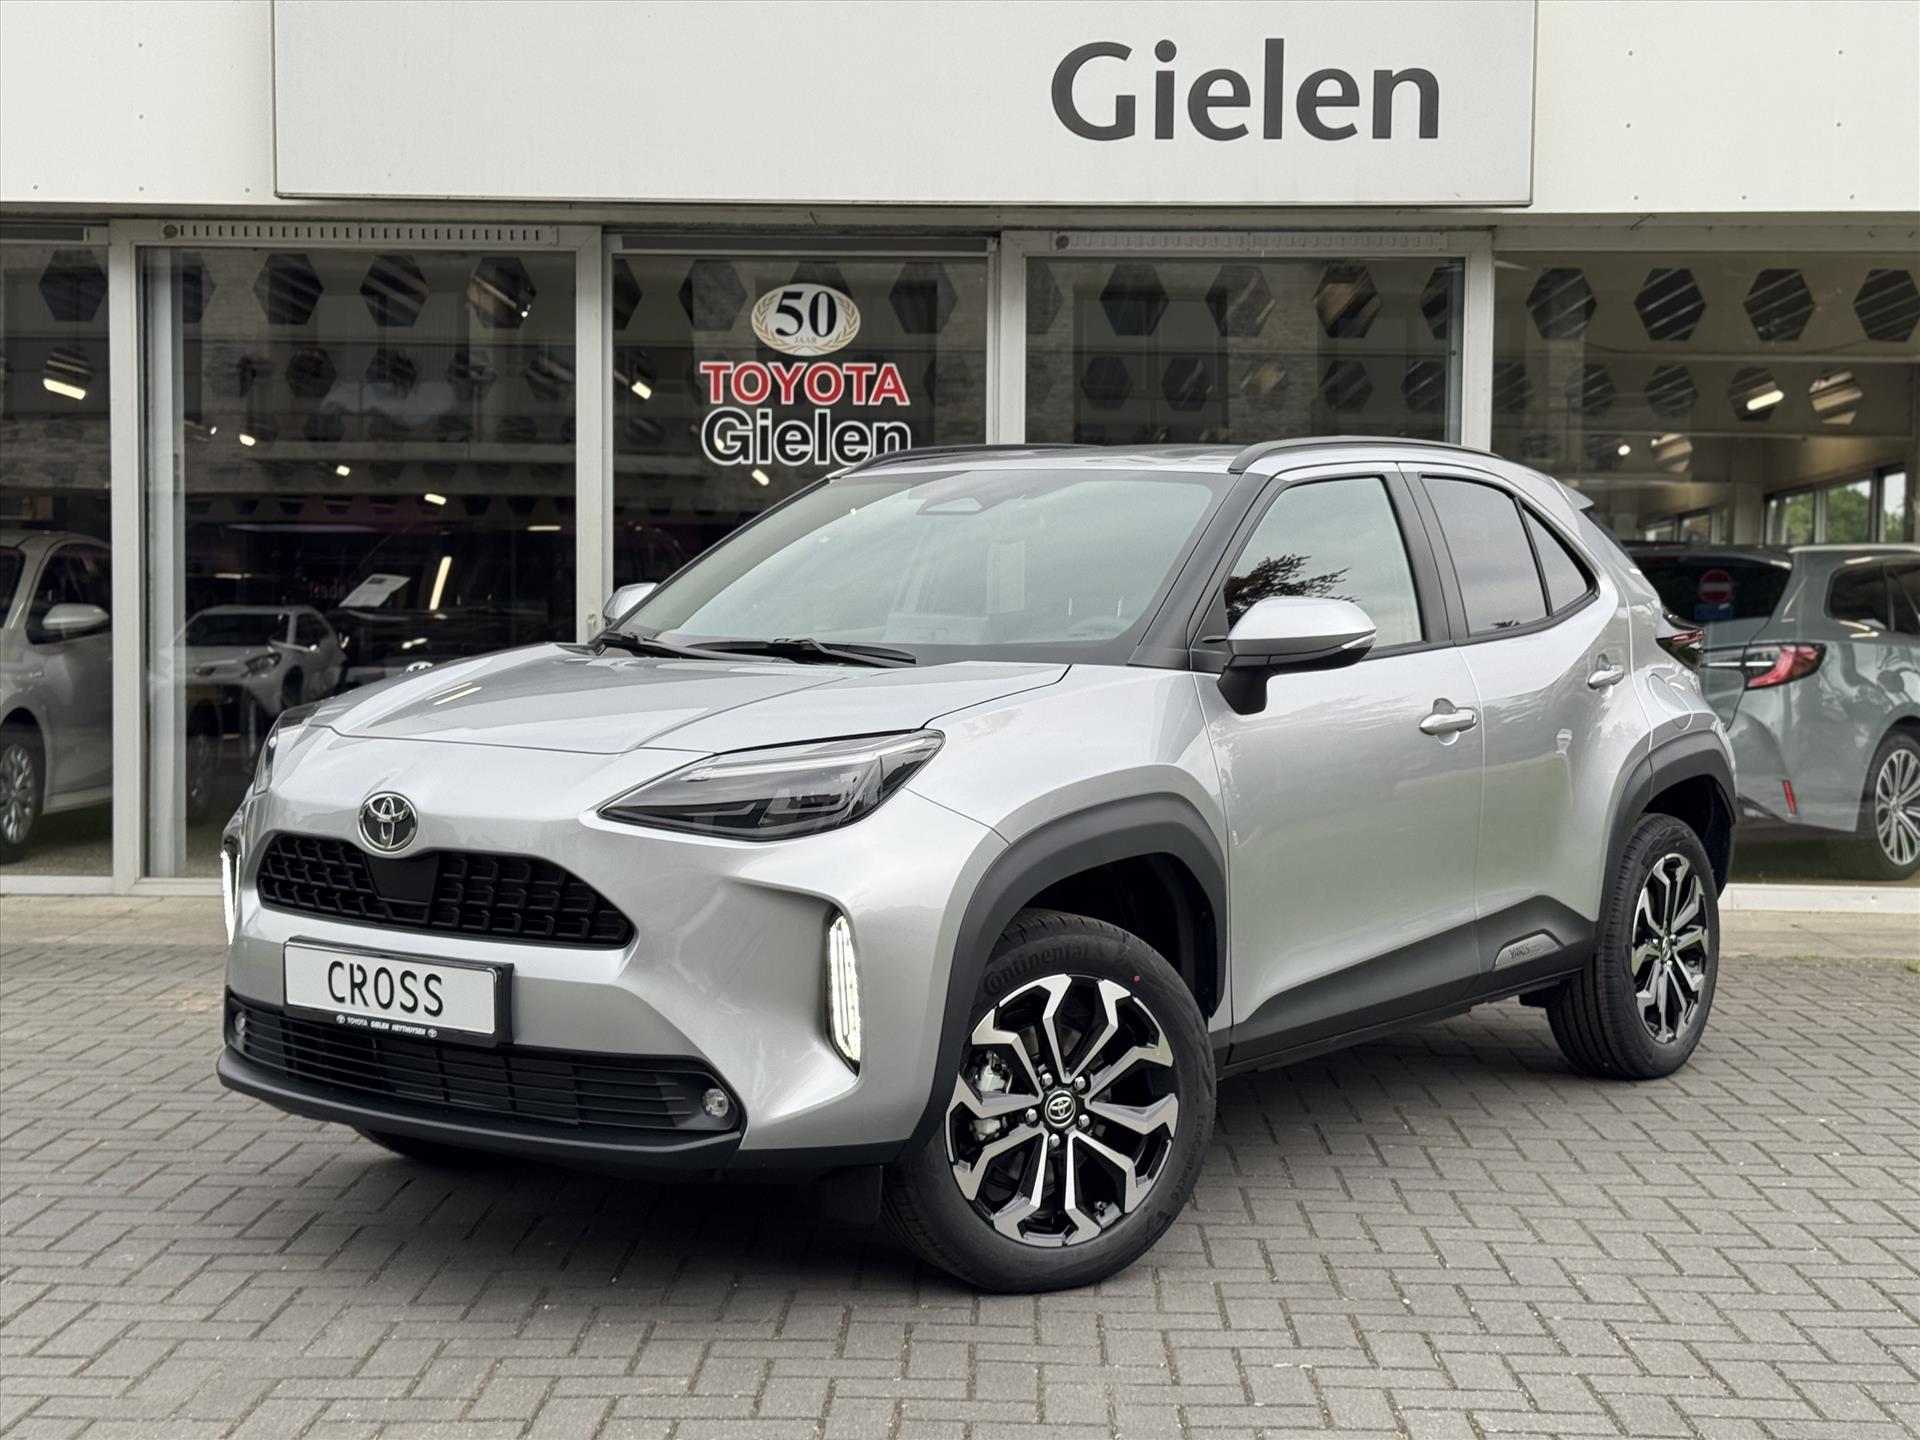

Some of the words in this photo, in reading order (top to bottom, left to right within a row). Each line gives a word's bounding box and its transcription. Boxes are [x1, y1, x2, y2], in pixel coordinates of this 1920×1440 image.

[1051, 38, 1440, 142] Gielen
[775, 290, 838, 338] 50
[794, 336, 818, 344] JAAR
[700, 361, 911, 405] TOYOTA
[701, 406, 912, 466] Gielen
[327, 960, 444, 1017] CROSS
[983, 943, 1089, 997] Continental
[346, 1016, 369, 1026] TOYOTA
